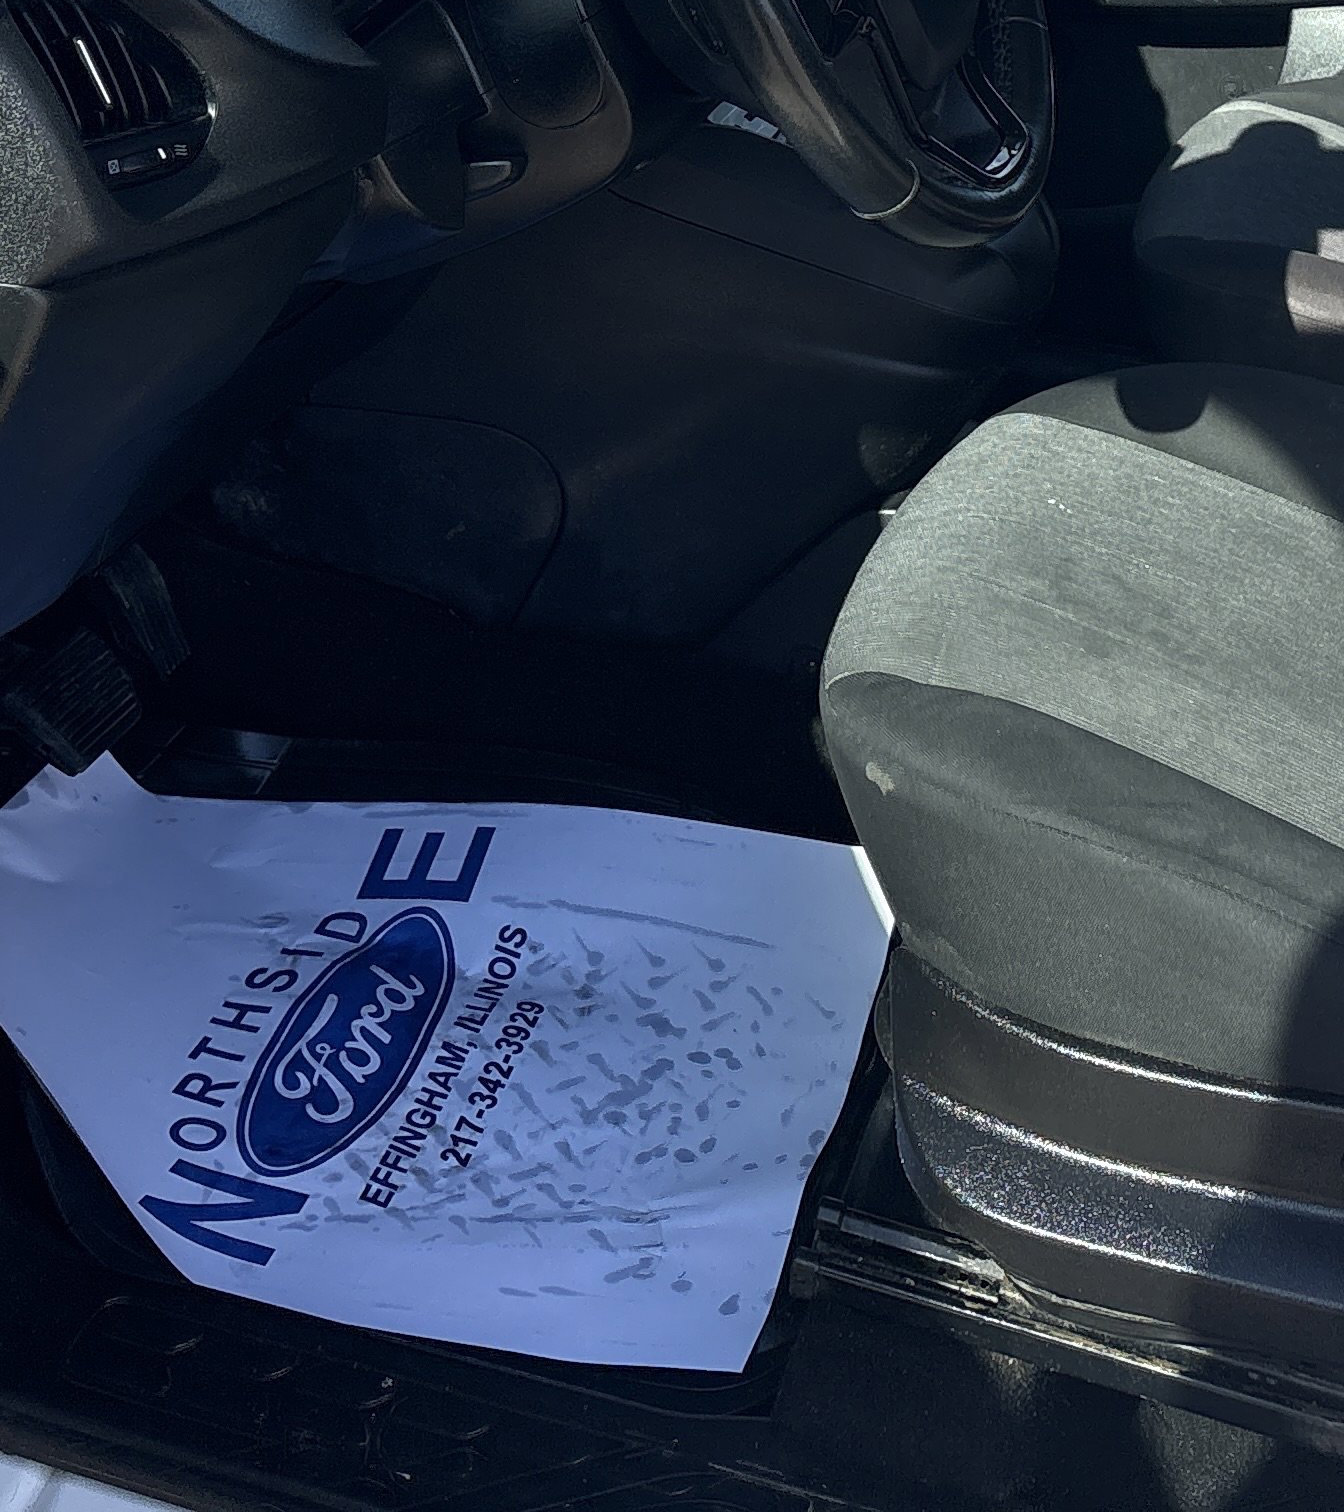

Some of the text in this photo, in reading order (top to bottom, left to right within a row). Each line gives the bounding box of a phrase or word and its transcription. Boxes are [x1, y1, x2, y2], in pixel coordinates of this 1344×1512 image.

[138, 825, 497, 1267] NORTHSIDE
[273, 964, 426, 1124] Ford
[358, 923, 529, 1209] EFFINGHAM, ILLINOIS
[440, 999, 545, 1169] 217-342-3929
